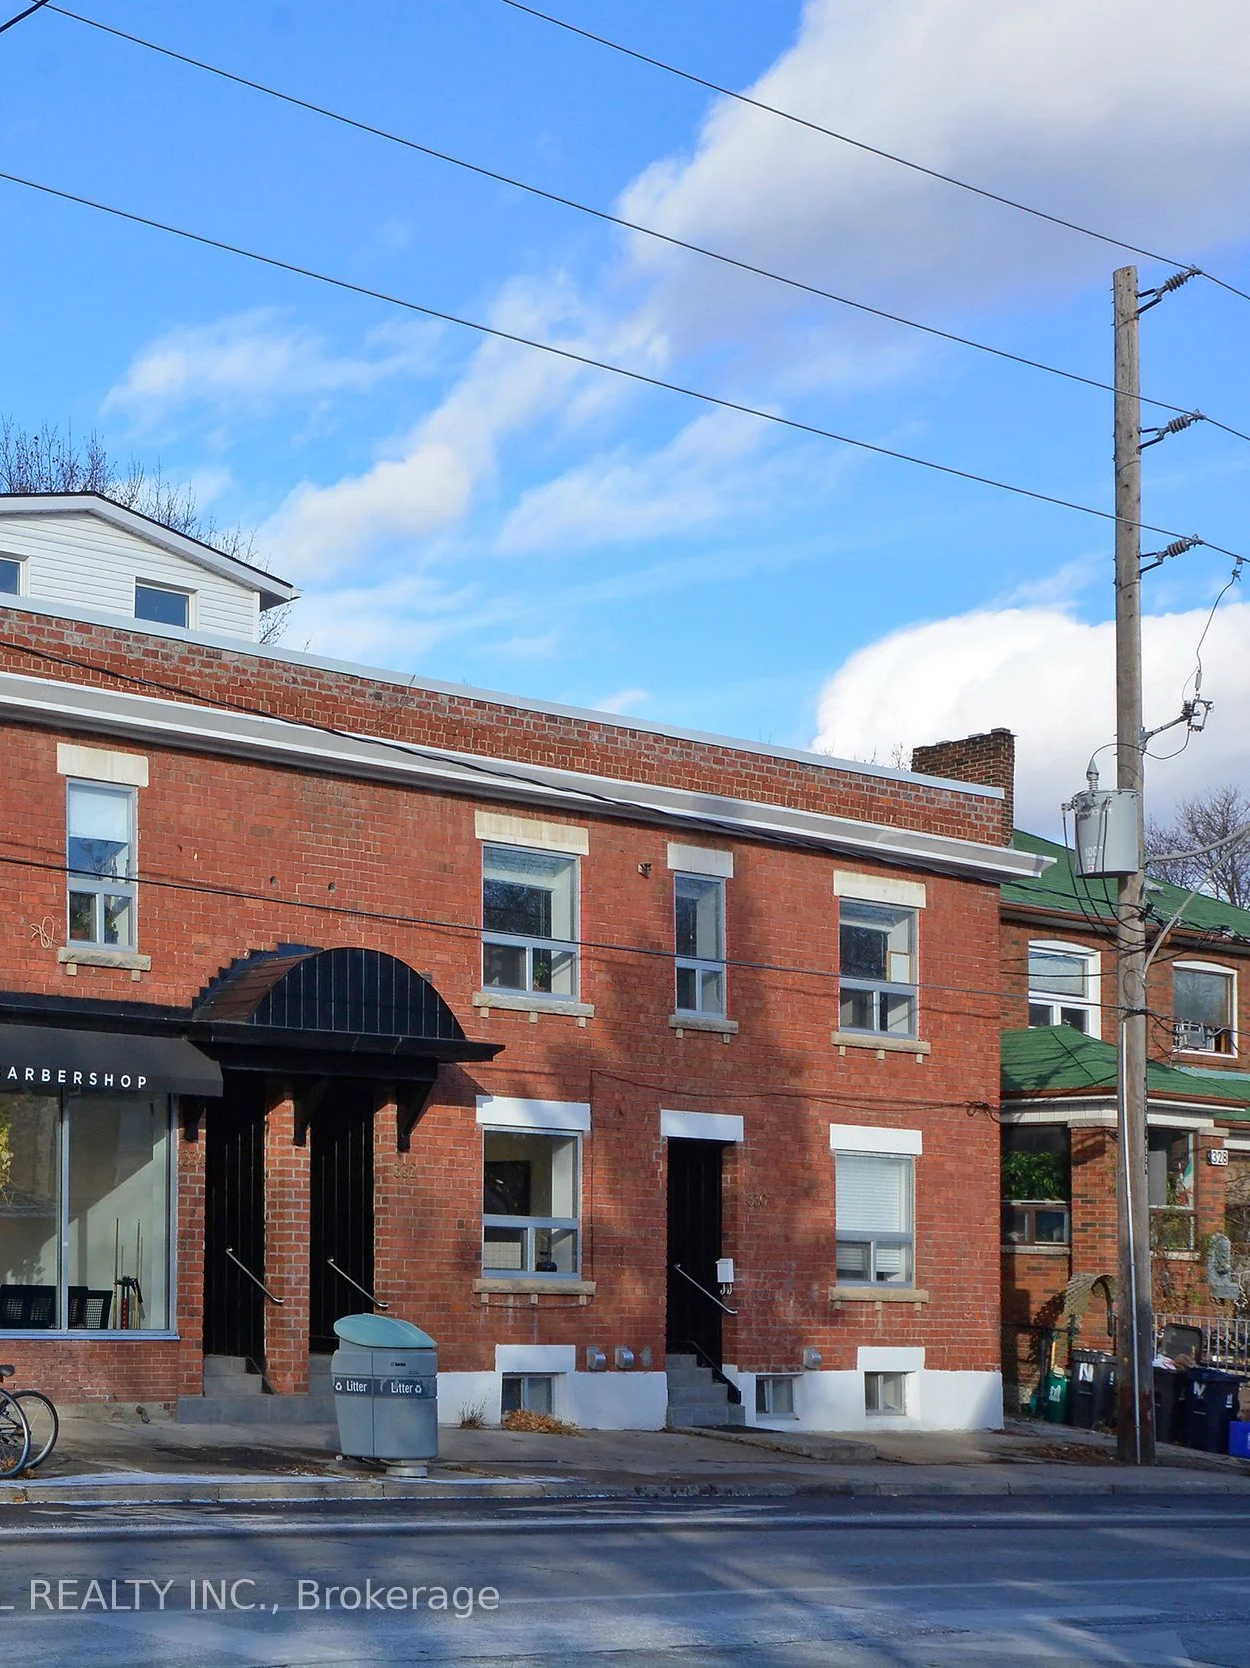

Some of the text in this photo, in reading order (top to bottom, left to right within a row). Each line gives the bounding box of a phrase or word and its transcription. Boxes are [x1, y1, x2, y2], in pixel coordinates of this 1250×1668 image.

[1212, 1151, 1227, 1163] 328
[346, 1380, 368, 1393] Litter
[391, 1382, 413, 1394] Litter
